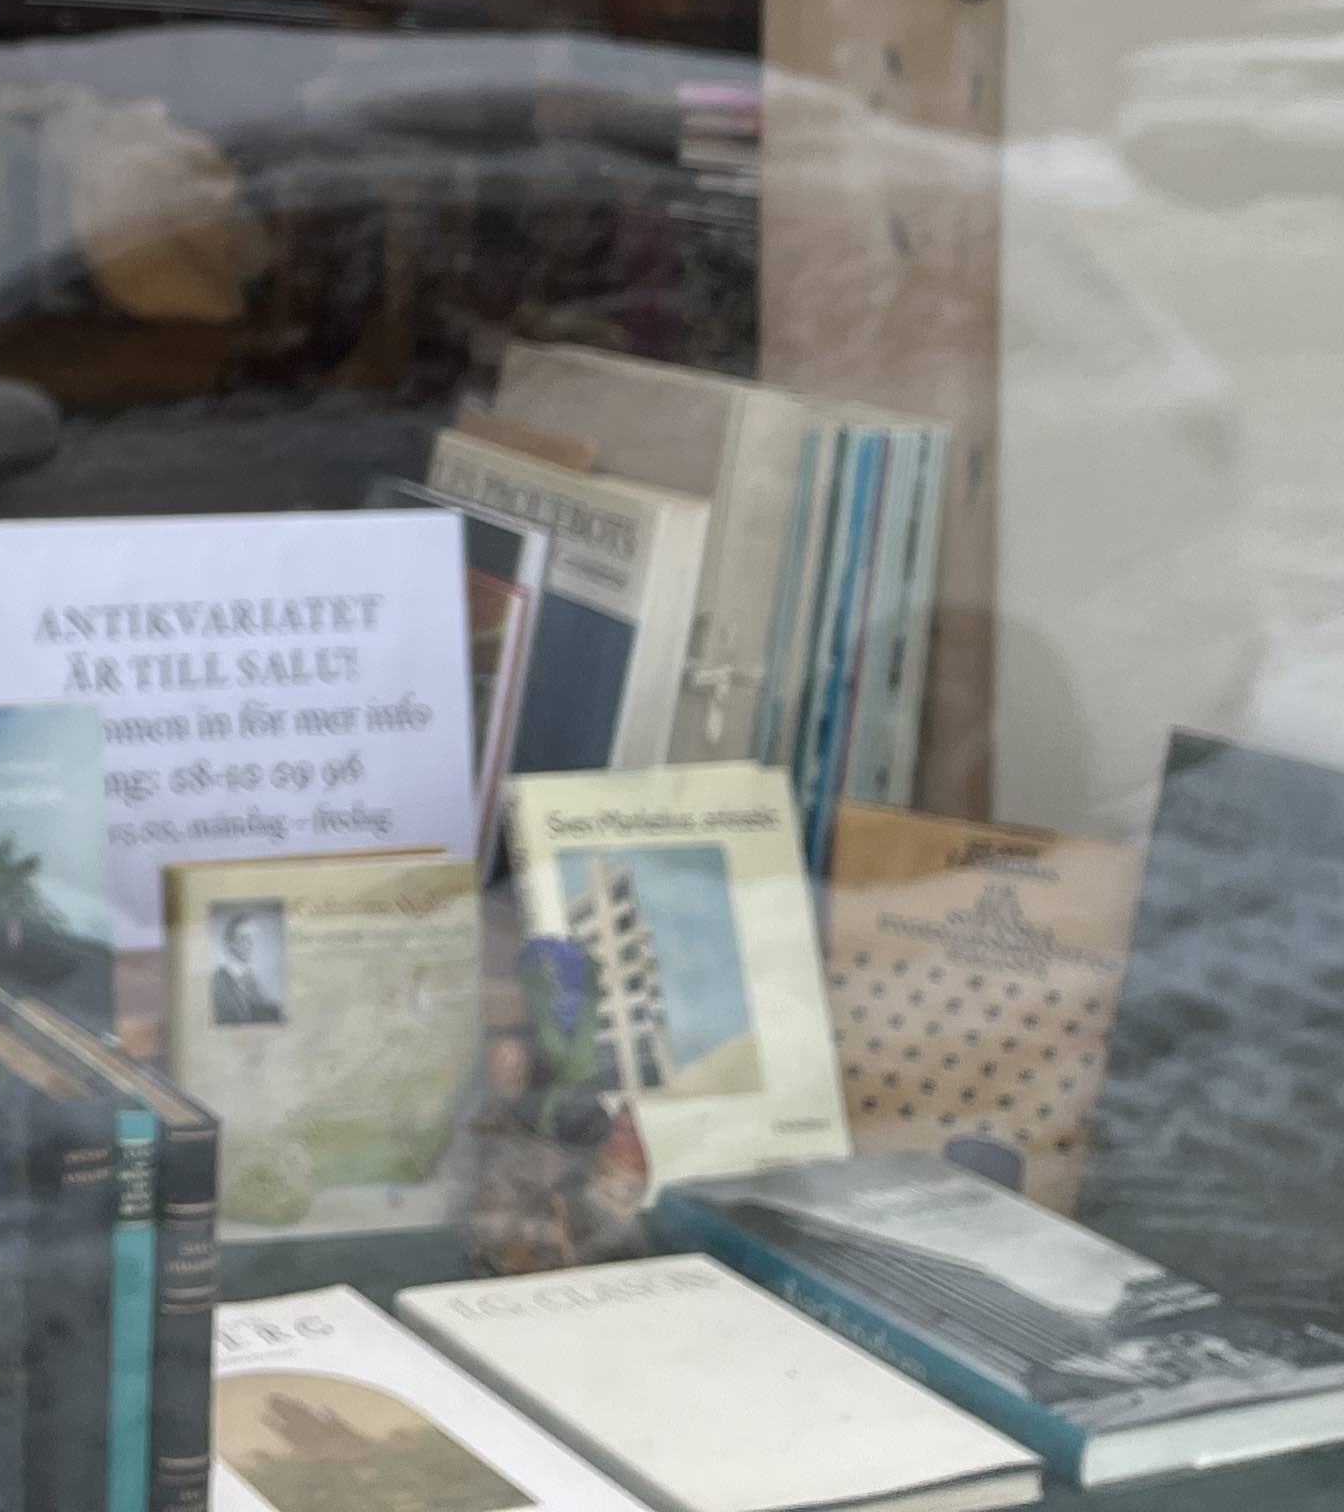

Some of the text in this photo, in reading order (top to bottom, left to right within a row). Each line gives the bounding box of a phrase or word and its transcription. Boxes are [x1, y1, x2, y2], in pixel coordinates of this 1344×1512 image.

[33, 594, 385, 646] ANTIKVARIATET
[64, 650, 124, 695] ÄR
[130, 651, 229, 691] TILL
[197, 703, 233, 741] in
[239, 697, 288, 740] för
[293, 704, 360, 737] mer
[365, 690, 433, 733] info
